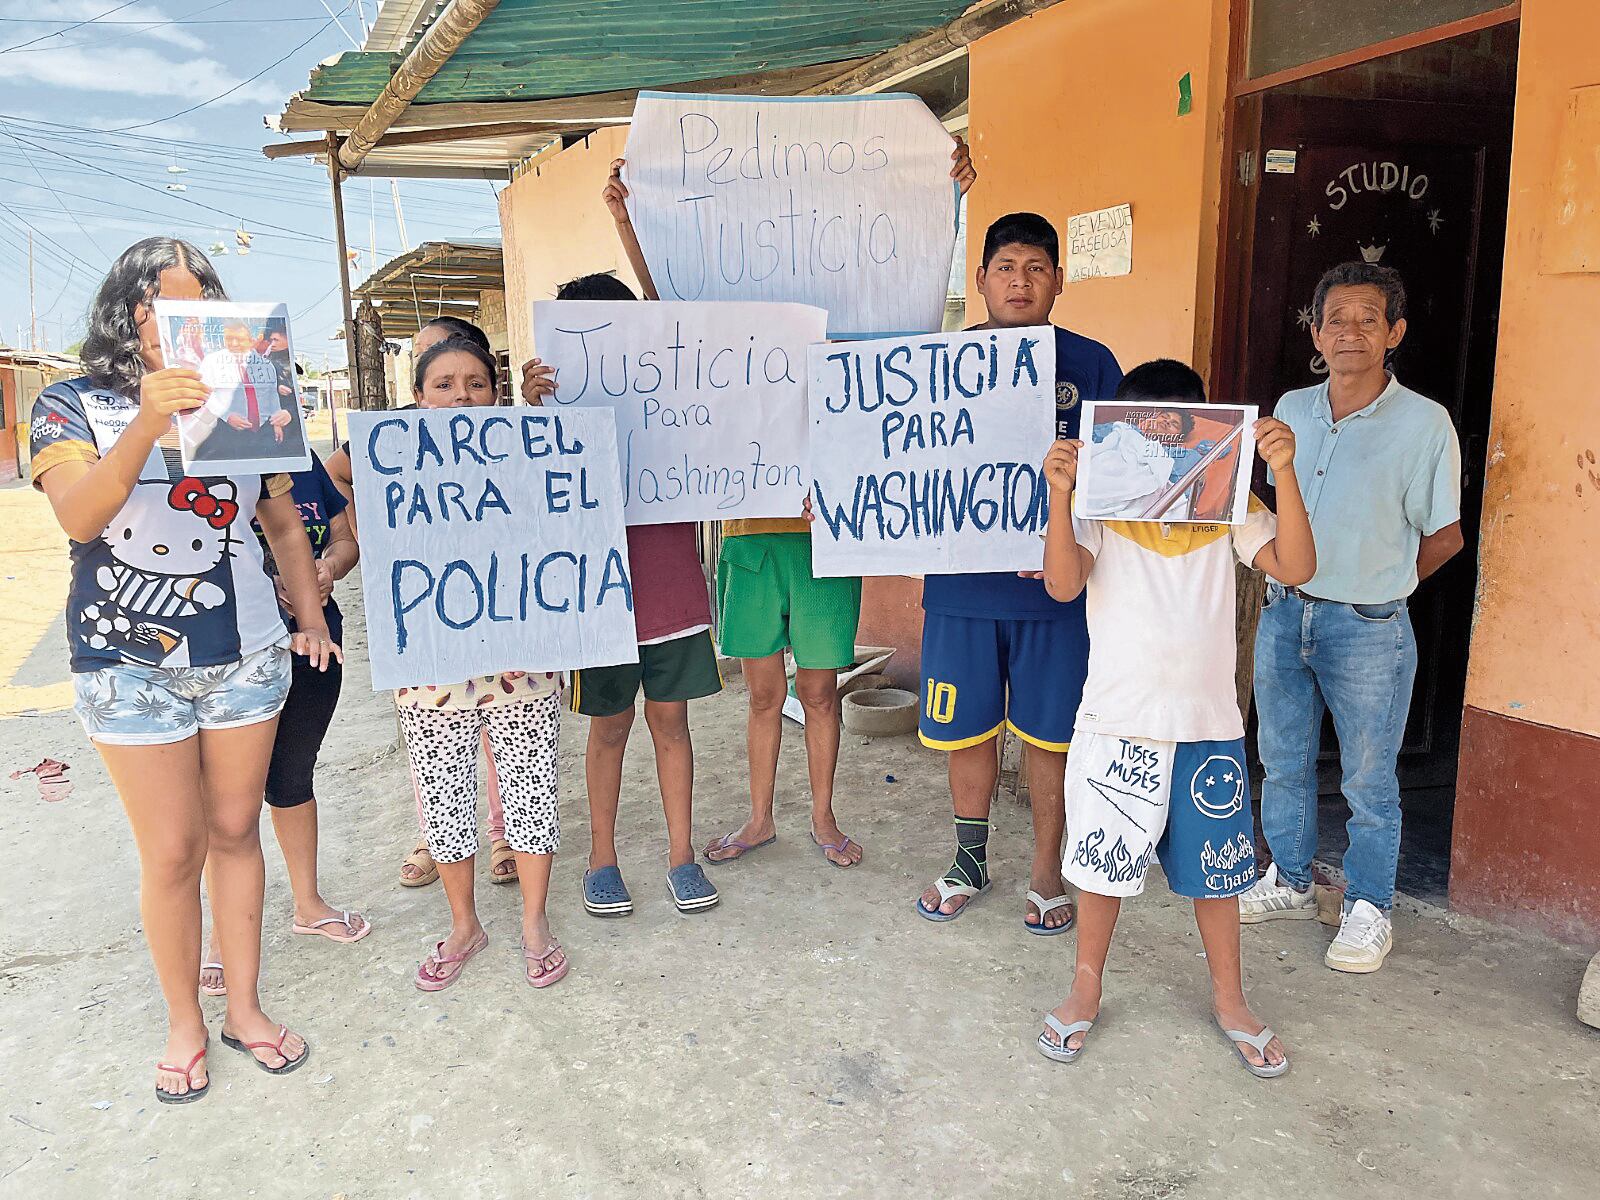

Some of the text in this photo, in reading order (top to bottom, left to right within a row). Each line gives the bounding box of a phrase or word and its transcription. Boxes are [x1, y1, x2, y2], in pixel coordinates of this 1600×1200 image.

[680, 112, 888, 186] Pedimos
[1325, 161, 1429, 210] STUDIO
[667, 189, 897, 301] Justicia
[1069, 207, 1132, 239] SE VENDE
[1072, 230, 1127, 254] GASEOSA
[1090, 253, 1097, 265] Y
[553, 321, 796, 404] Justicia
[644, 398, 711, 429] Para
[882, 408, 974, 459] PARA
[368, 414, 584, 475] CARCEL
[385, 467, 599, 528] PARA EL
[391, 547, 633, 654] POLICIA
[926, 678, 957, 724] 10
[1106, 759, 1161, 793] MUSES
[1206, 862, 1255, 891] Chaos
